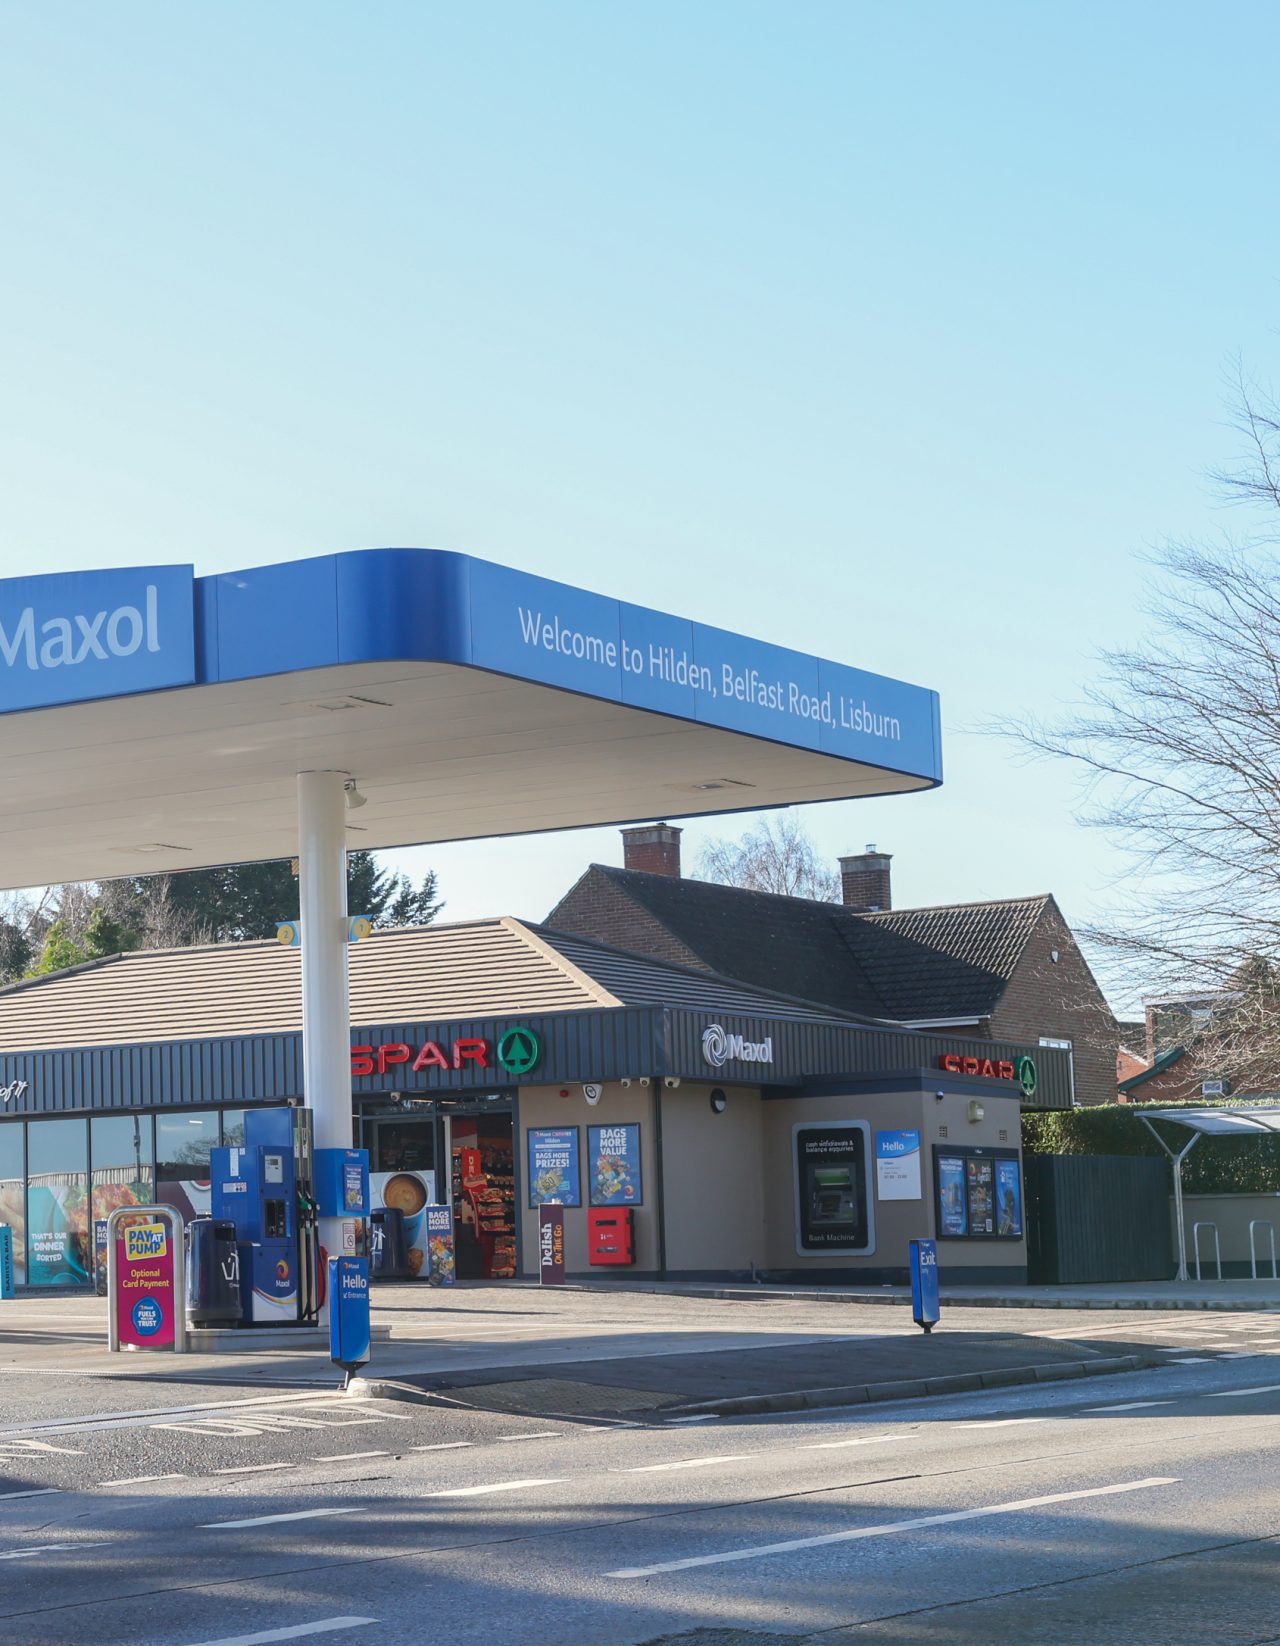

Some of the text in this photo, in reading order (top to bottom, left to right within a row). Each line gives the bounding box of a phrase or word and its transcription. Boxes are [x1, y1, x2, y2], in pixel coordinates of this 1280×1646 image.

[518, 606, 901, 742] Welcome to Hilden, Belfast Road, Lisburn
[727, 1033, 774, 1064] Maxol
[351, 1038, 490, 1075] SPAR
[0, 1080, 15, 1102] of
[14, 1080, 30, 1098] it
[600, 1128, 627, 1138] BAGS
[600, 1138, 627, 1147] MORE
[882, 1142, 905, 1151] Hello
[600, 1146, 627, 1155] VALUE
[535, 1158, 570, 1168] PRIZES!
[428, 1211, 450, 1219] BAGS
[129, 1230, 162, 1243] PAY AT
[33, 1242, 64, 1251] DINNER
[129, 1243, 161, 1255] PUMP
[542, 1223, 553, 1266] Delish
[554, 1239, 563, 1252] THE
[36, 1254, 62, 1262] SORTED
[554, 1253, 563, 1264] ON
[921, 1250, 936, 1265] Exit
[131, 1269, 160, 1278] Optional
[122, 1279, 170, 1290] Card Payment
[276, 1280, 290, 1288] Maxol
[343, 1275, 367, 1288] Hello
